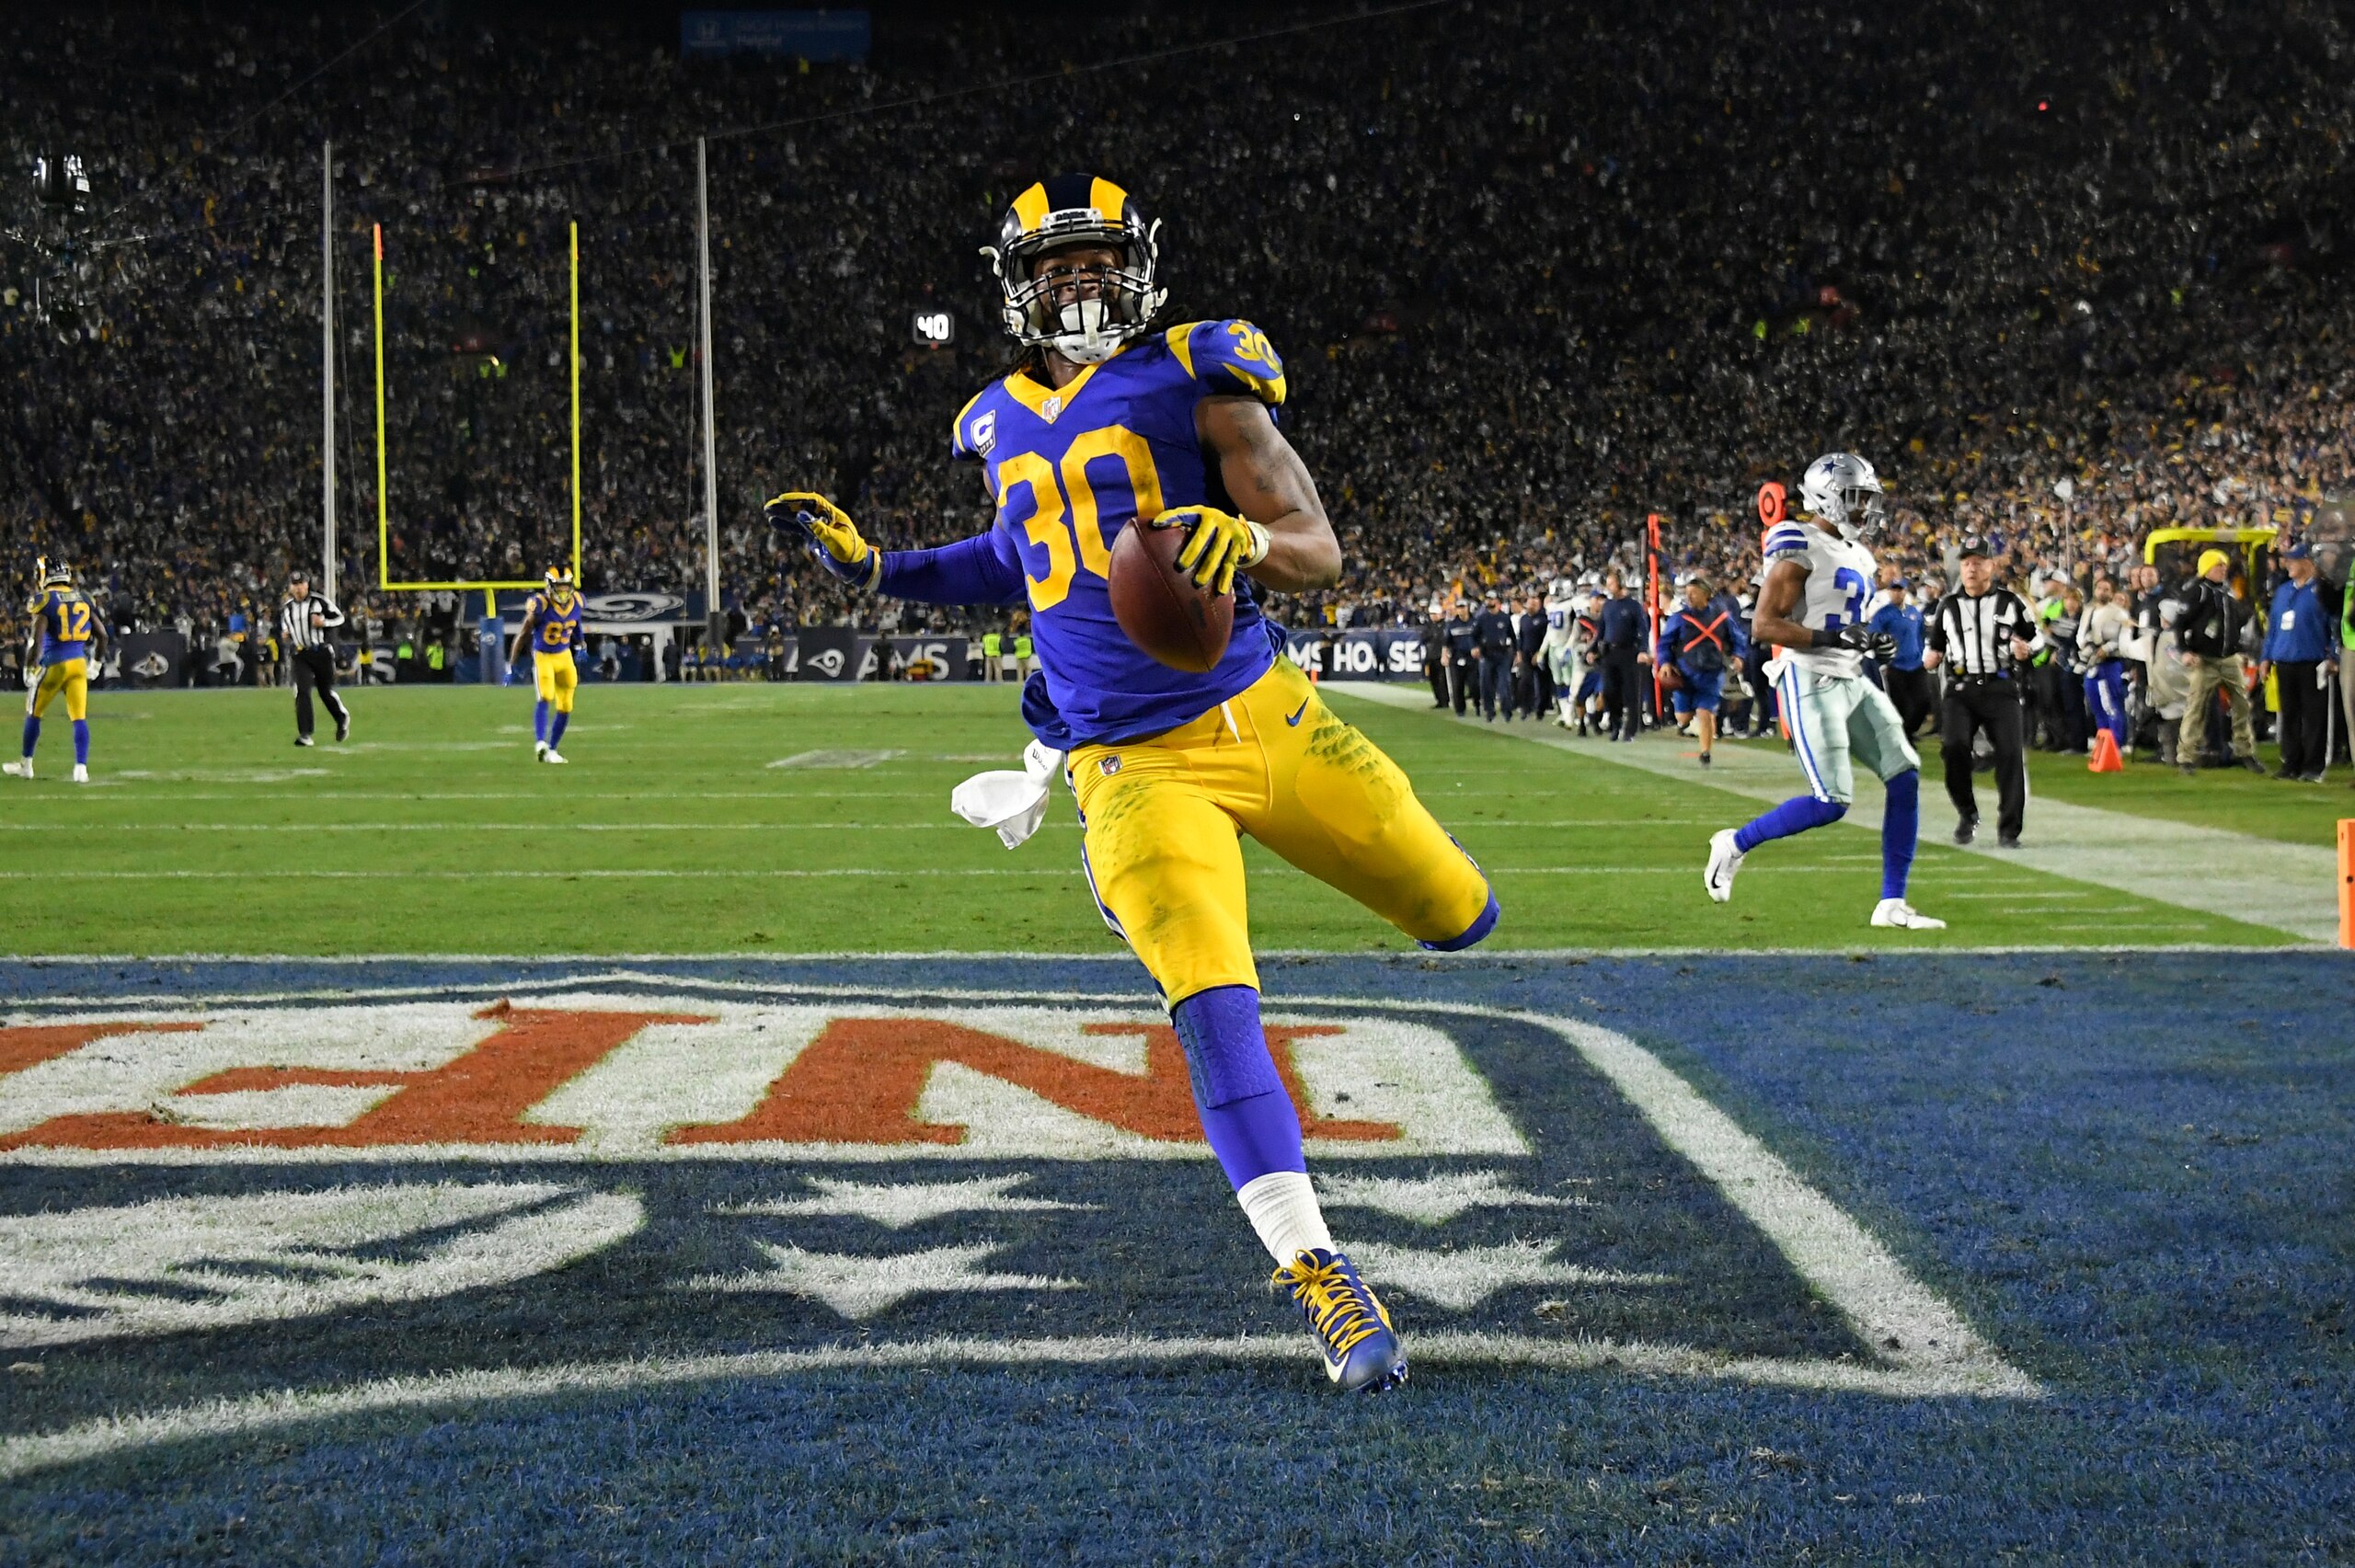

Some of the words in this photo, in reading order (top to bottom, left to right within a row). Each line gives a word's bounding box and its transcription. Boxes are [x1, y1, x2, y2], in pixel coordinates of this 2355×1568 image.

[917, 314, 948, 340] 40
[1227, 323, 1281, 374] 30
[973, 414, 994, 447] C
[997, 424, 1166, 612] 30
[57, 601, 91, 641] 12
[1334, 640, 1422, 672] HOSE
